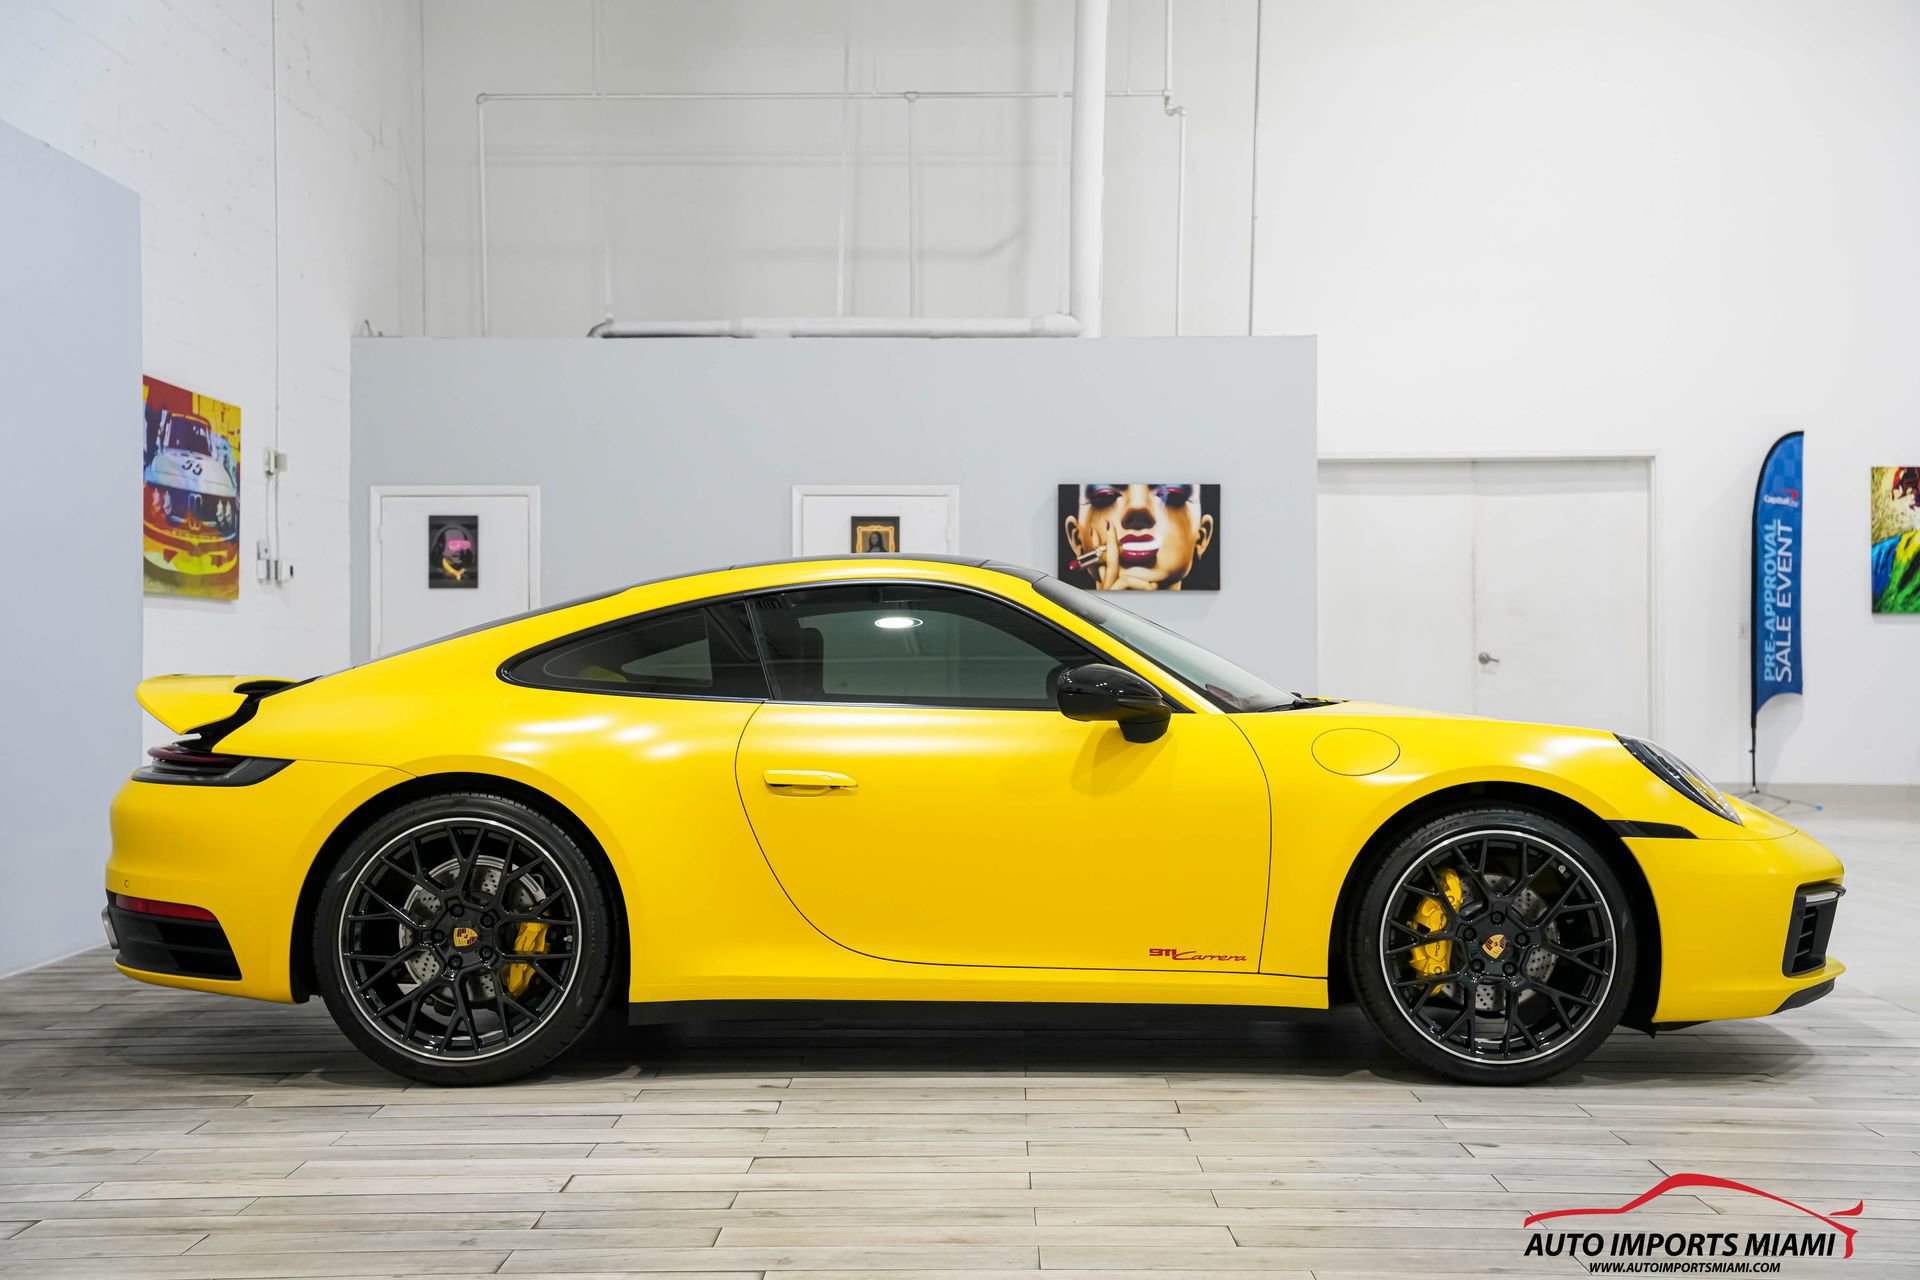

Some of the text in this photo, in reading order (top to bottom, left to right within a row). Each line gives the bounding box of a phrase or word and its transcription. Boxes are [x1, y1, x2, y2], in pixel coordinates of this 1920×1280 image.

[1764, 519, 1777, 681] PRE-APPROVAL
[1777, 519, 1792, 608] EVENT
[1776, 616, 1792, 683] SALE
[1172, 951, 1248, 962] Carrera
